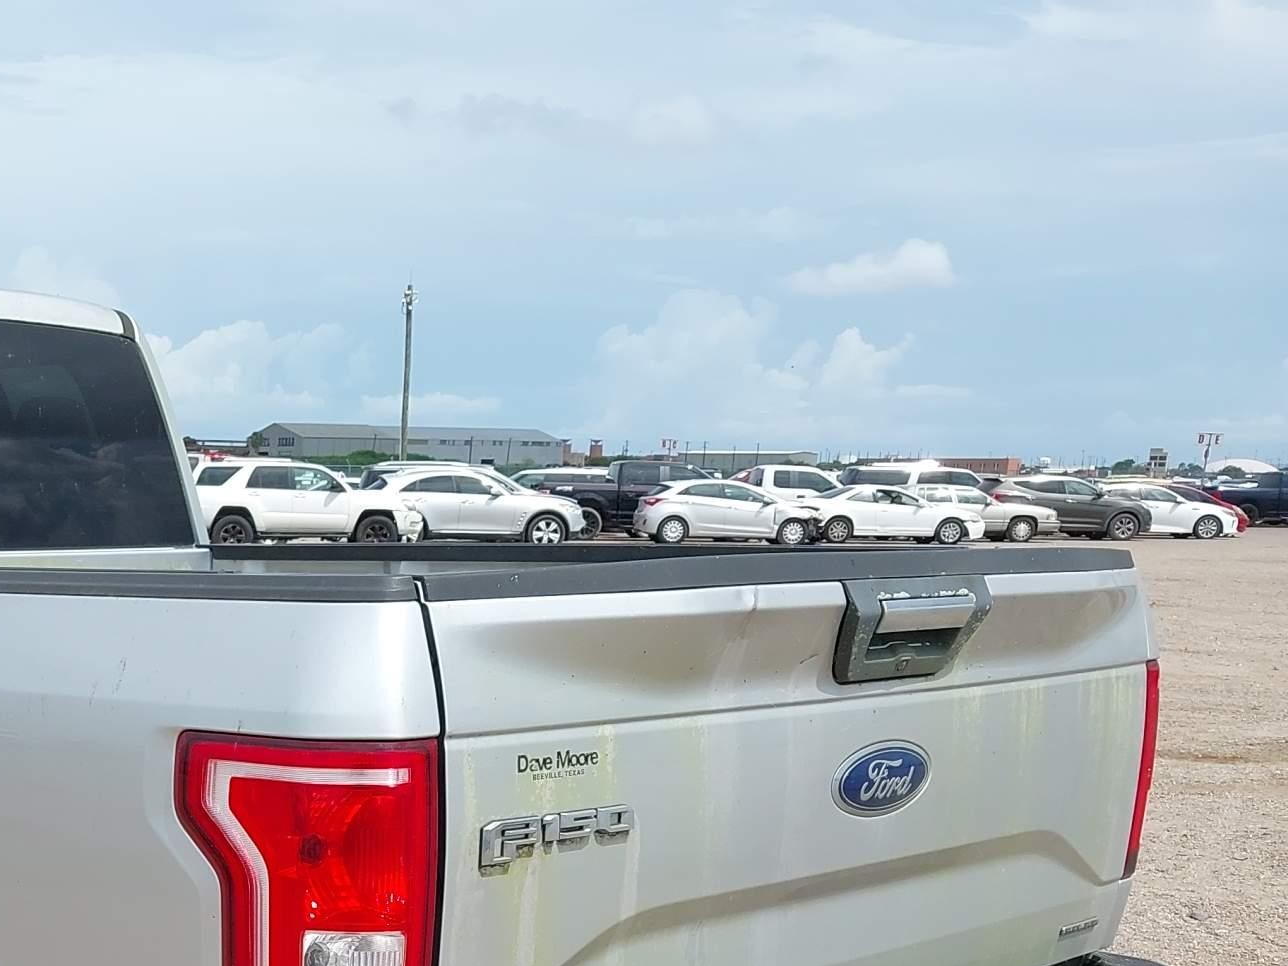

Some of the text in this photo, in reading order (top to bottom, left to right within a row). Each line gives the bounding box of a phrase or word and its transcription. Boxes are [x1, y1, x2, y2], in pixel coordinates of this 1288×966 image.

[517, 749, 599, 774] Dave Moore
[565, 768, 585, 777] TEXAS
[860, 758, 915, 801] Ford
